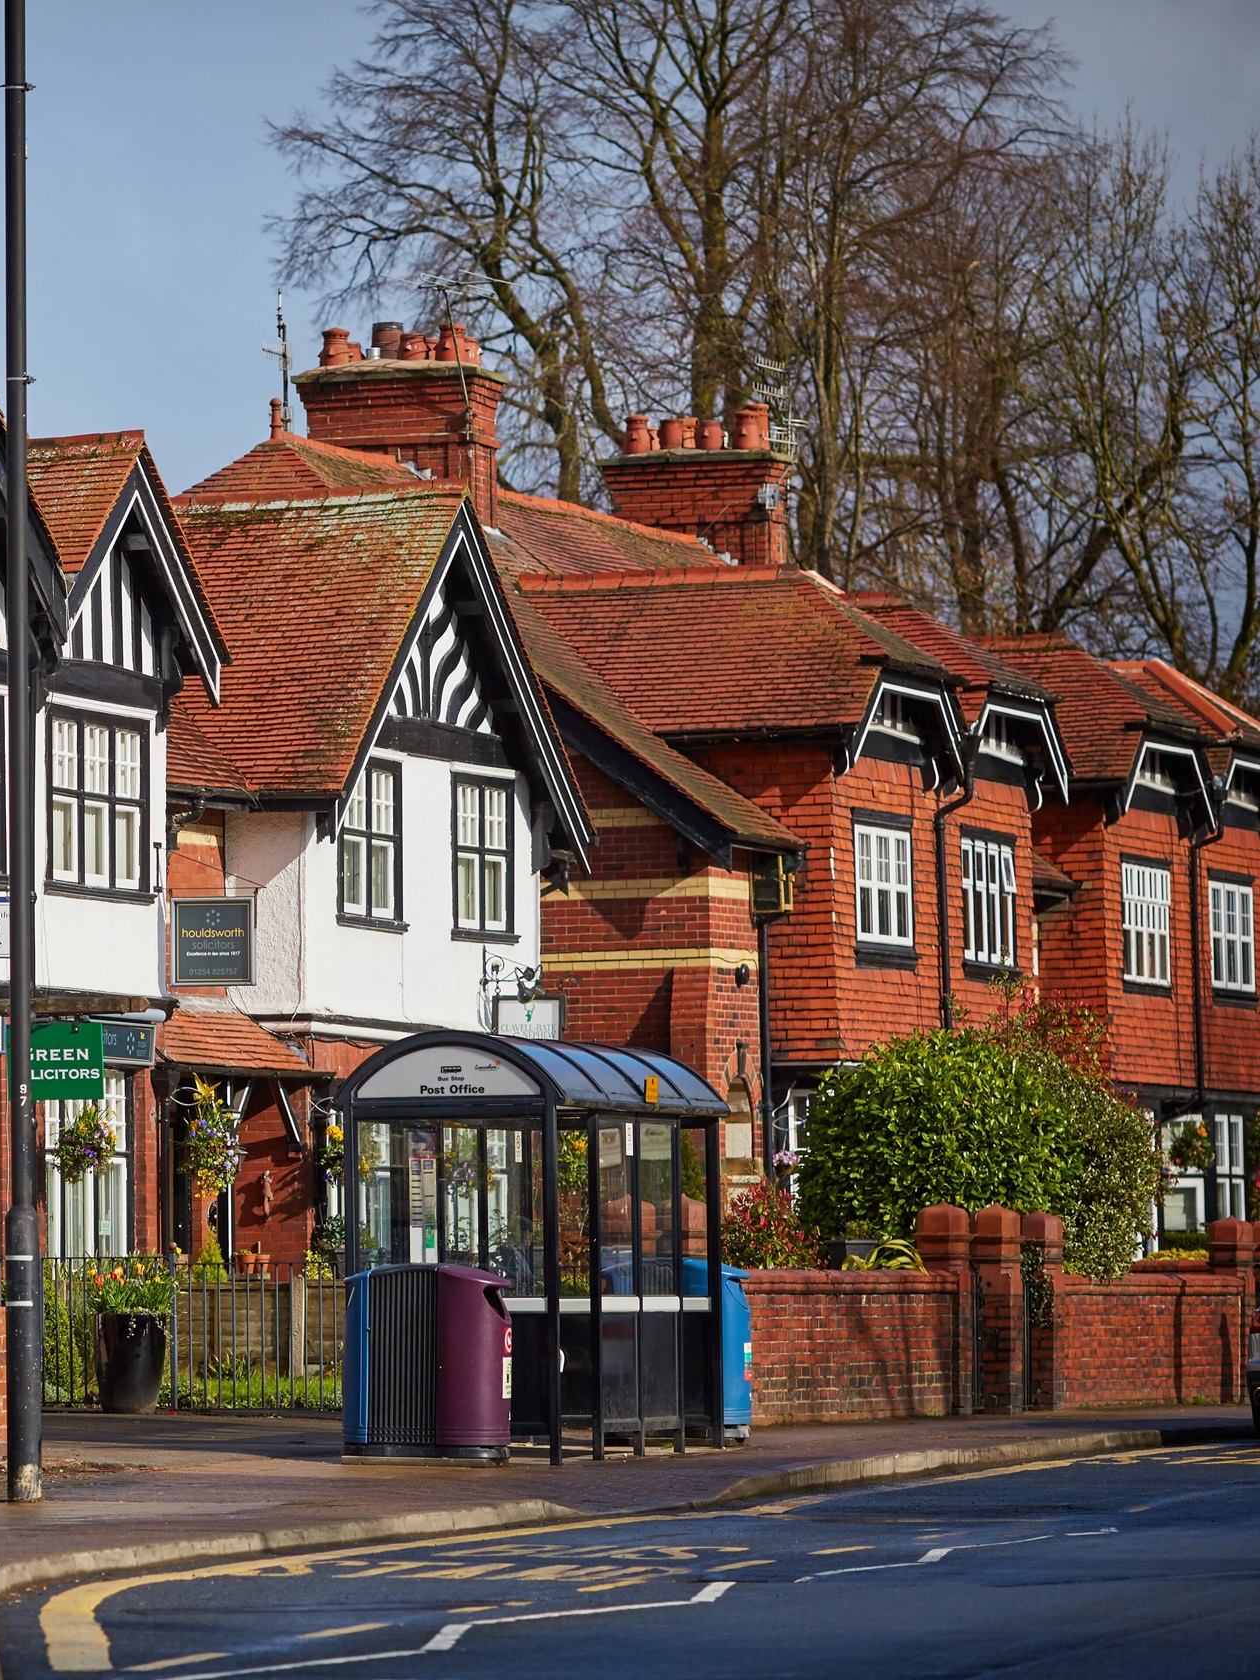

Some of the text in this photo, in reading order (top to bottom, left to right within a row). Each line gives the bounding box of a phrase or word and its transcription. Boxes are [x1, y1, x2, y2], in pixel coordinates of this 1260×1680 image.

[181, 928, 245, 938] houldsworth
[192, 940, 235, 950] solicitors
[189, 968, 238, 976] 01254 825757
[31, 1068, 100, 1080] LICITORS
[420, 1085, 485, 1094] Post Office
